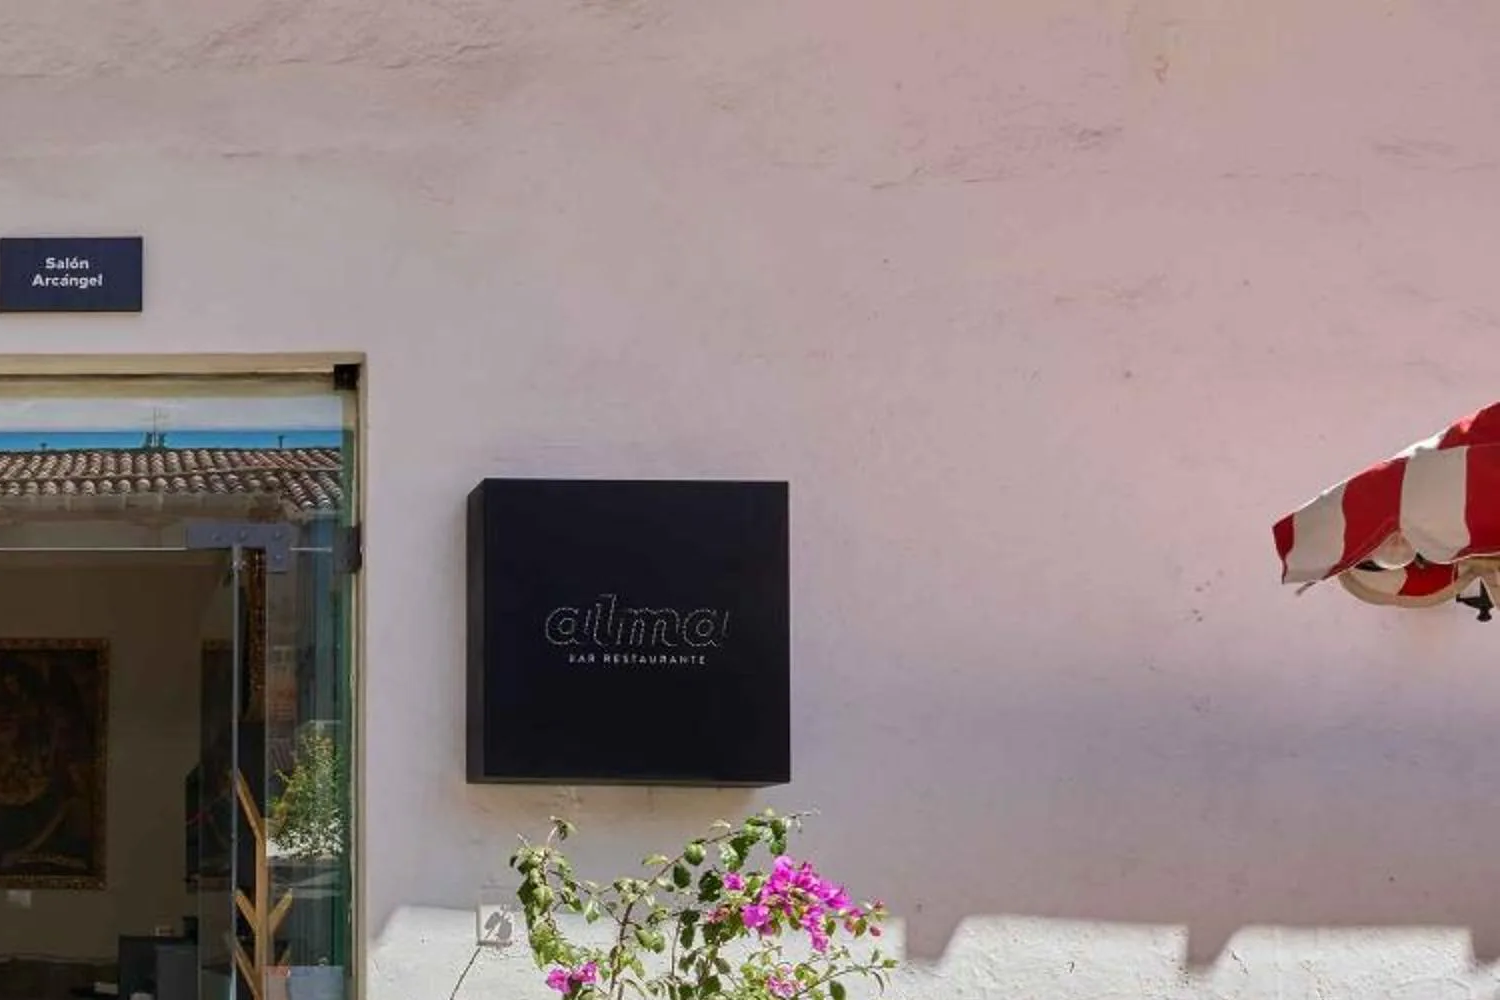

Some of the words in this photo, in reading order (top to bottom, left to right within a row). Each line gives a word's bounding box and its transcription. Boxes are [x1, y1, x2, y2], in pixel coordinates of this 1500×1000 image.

[45, 256, 89, 269] Salón
[31, 273, 103, 288] Arcángel
[545, 594, 729, 648] alma
[569, 653, 595, 664] BAR
[603, 653, 706, 665] RESTAURANTE
